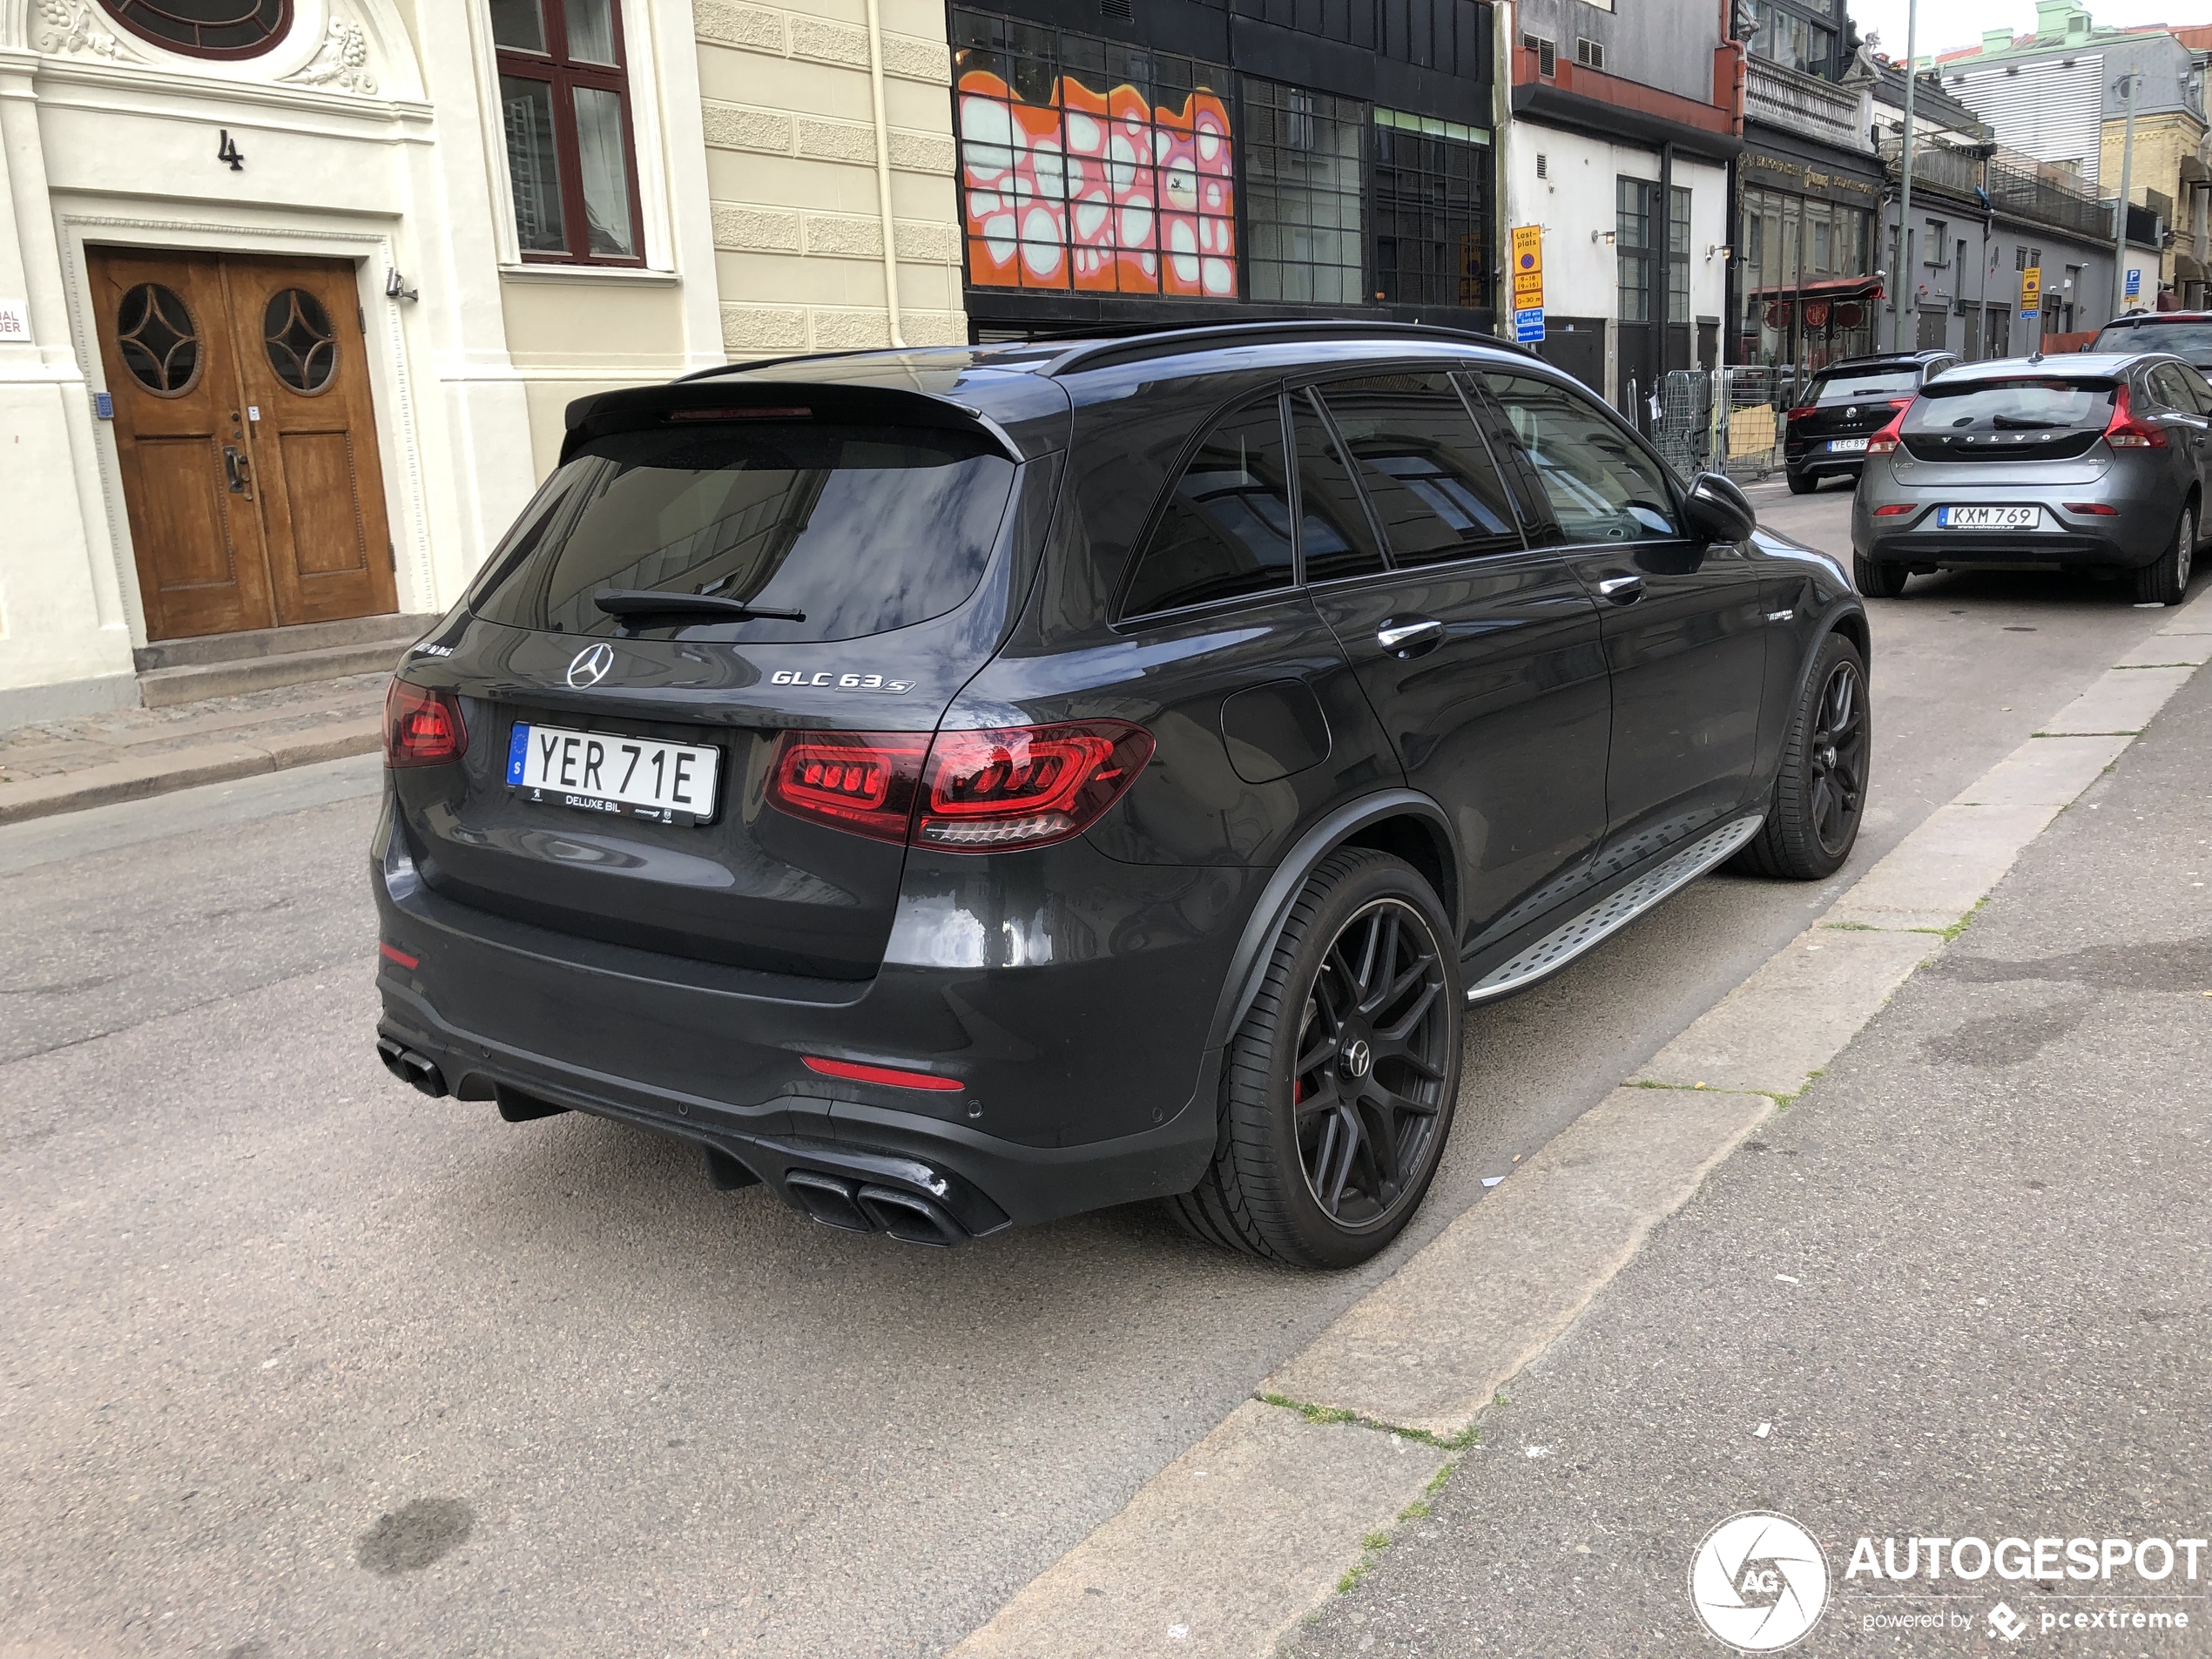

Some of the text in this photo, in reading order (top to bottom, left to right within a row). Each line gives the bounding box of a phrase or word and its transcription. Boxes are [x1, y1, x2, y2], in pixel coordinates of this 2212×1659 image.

[218, 130, 244, 171] 4
[1516, 231, 1536, 239] Last-
[1517, 239, 1536, 249] plats
[1835, 440, 1851, 448] YEC
[1942, 434, 2051, 443] VOLVO
[1953, 509, 1989, 523] KXM
[1995, 509, 2031, 523] 769
[771, 671, 833, 687] GLC
[513, 733, 697, 805] S YER 71E
[565, 795, 621, 813] DELUXE BIL
